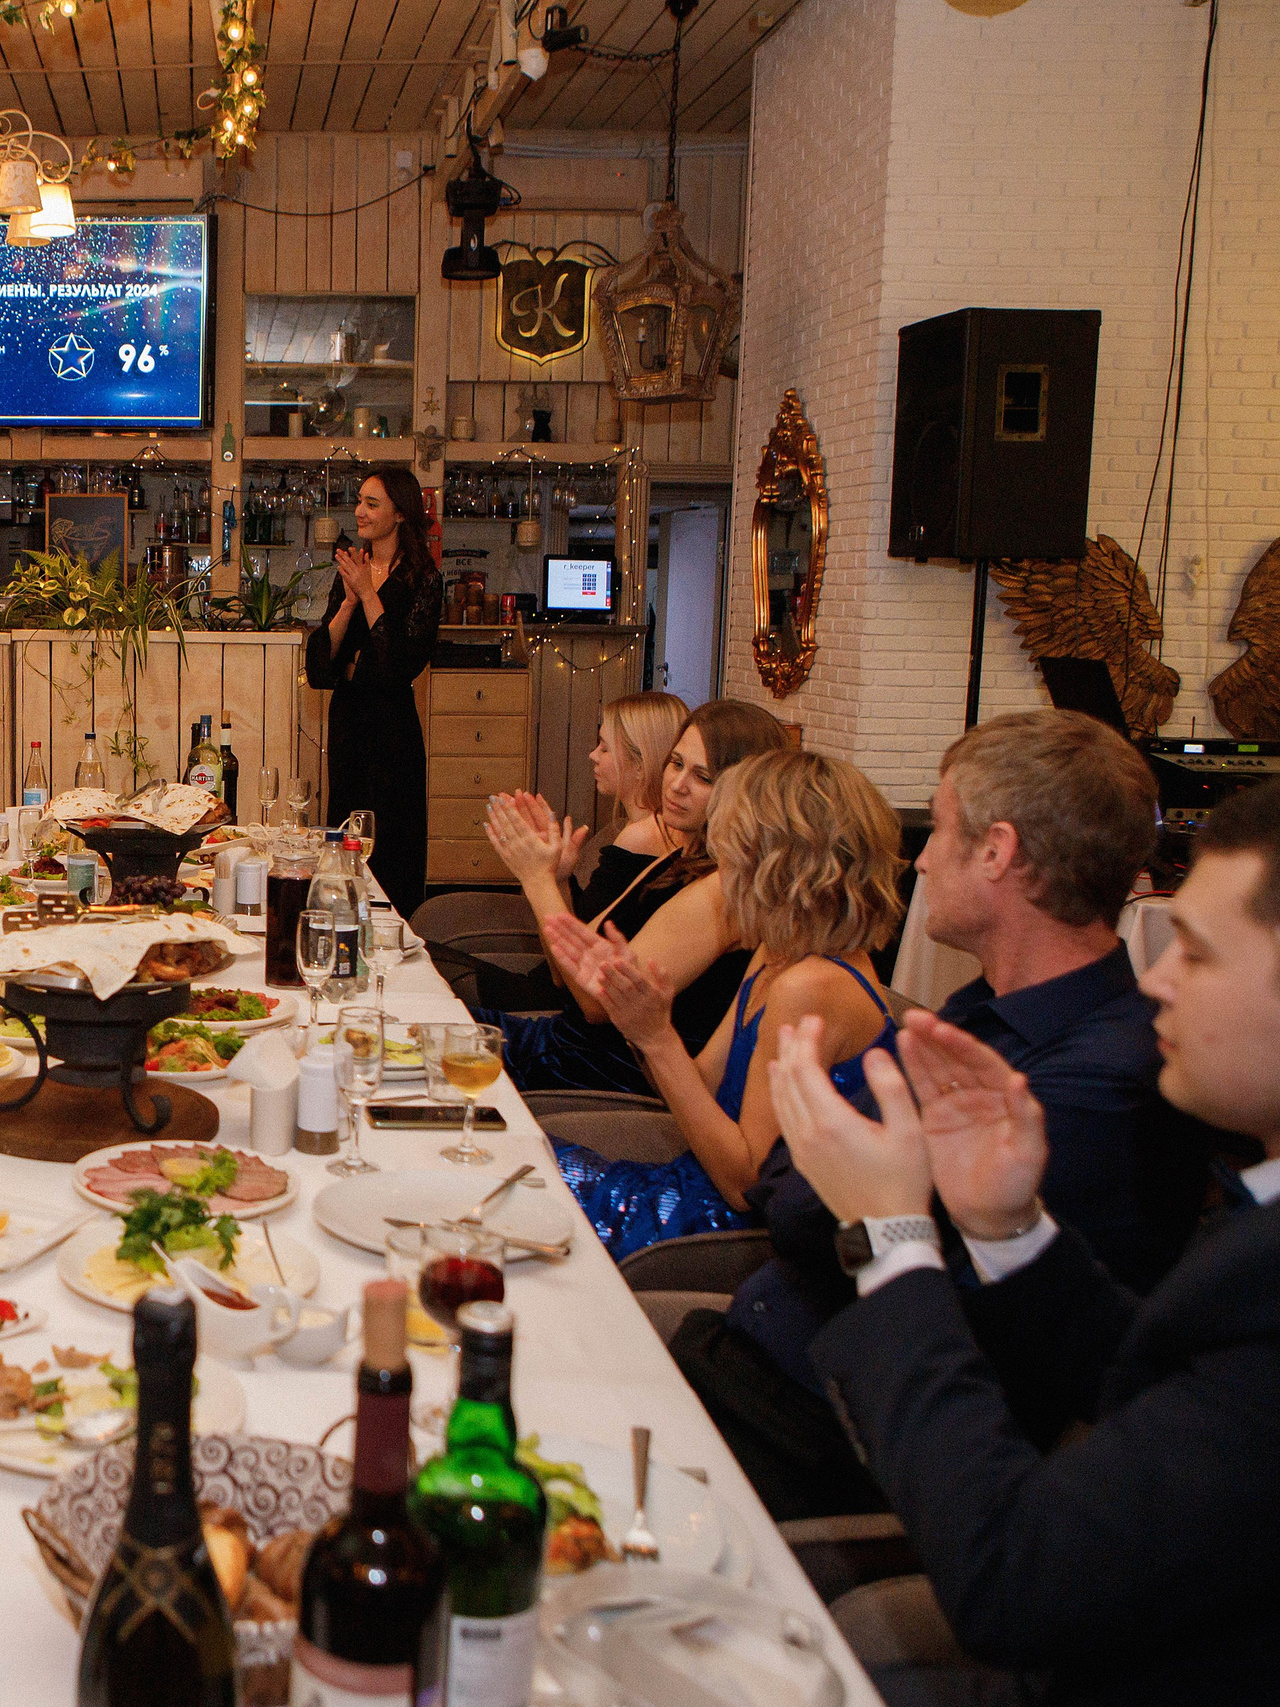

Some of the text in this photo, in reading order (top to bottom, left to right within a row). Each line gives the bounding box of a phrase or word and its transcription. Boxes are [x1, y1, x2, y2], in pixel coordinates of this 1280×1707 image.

[49, 284, 122, 298] РЕЗУЛЬТАТ
[125, 284, 158, 298] 2024
[118, 343, 169, 373] 96 %
[563, 563, 596, 571] r_keeper
